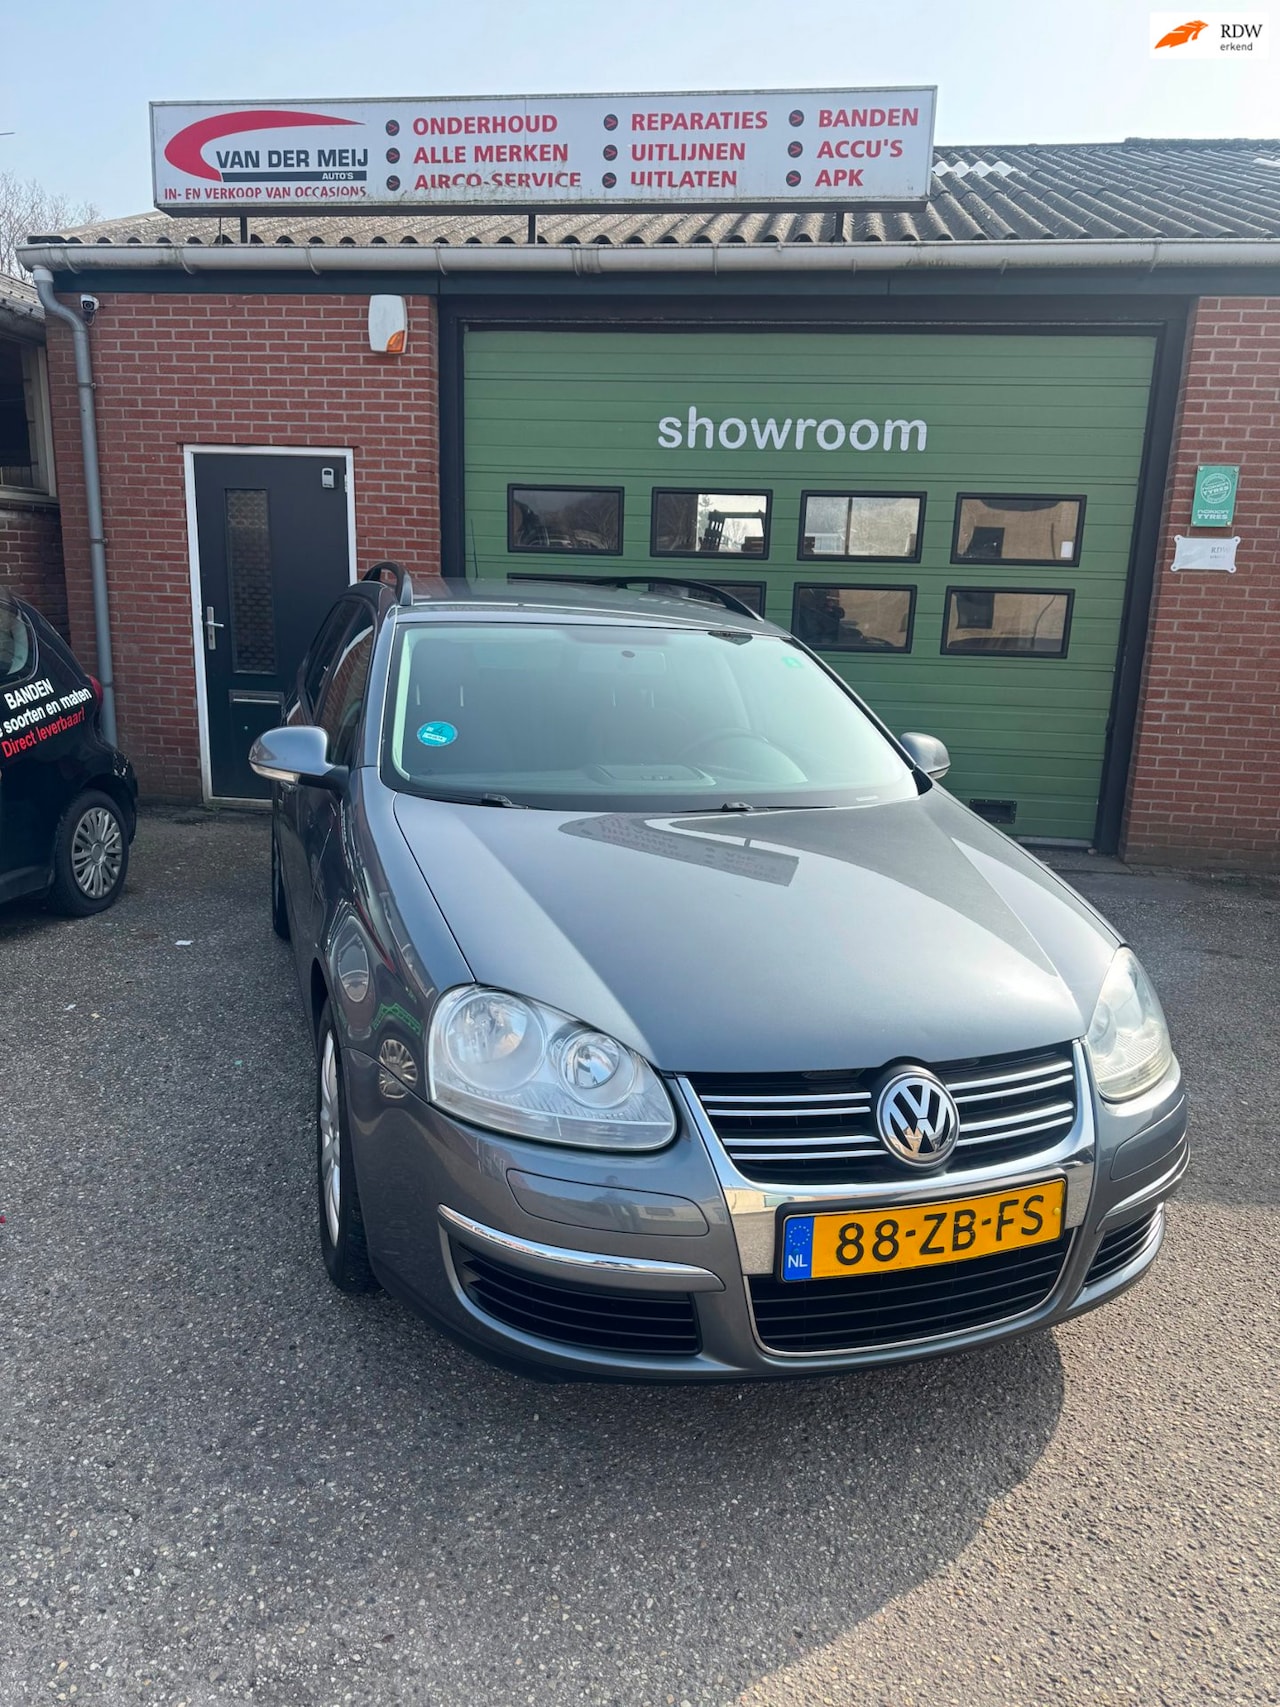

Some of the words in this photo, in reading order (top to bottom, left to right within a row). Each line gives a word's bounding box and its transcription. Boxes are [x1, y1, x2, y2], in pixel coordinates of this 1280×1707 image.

[413, 115, 558, 135] ONDERHOUD
[631, 111, 768, 131] REPARATIES
[818, 108, 919, 128] BANDEN
[216, 150, 260, 169] VAN
[268, 149, 310, 168] DER
[317, 148, 369, 167] MEIJ
[413, 146, 466, 164] ALLE
[474, 143, 569, 163] MERKEN
[631, 143, 746, 161] UITLIJNEN
[816, 139, 903, 158] ACCU'S
[322, 171, 354, 180] AUTO'S
[414, 172, 581, 190] AIRCO-SERVICE
[630, 170, 738, 188] UITLATEN
[814, 169, 864, 187] APK
[164, 188, 182, 200] IN-
[185, 187, 201, 200] EN
[204, 187, 262, 199] VERKOOP
[265, 186, 291, 199] VAN
[294, 185, 368, 199] OCCASIONS
[658, 405, 928, 451] showroom
[4, 678, 55, 710] BANDEN
[3, 708, 46, 734] soorten
[45, 700, 61, 716] en
[60, 687, 92, 710] maten
[1, 730, 37, 758] Direct
[36, 705, 86, 742] leverbaar!
[835, 1194, 1045, 1266] 88-ZB-FS
[787, 1254, 808, 1268] NL
